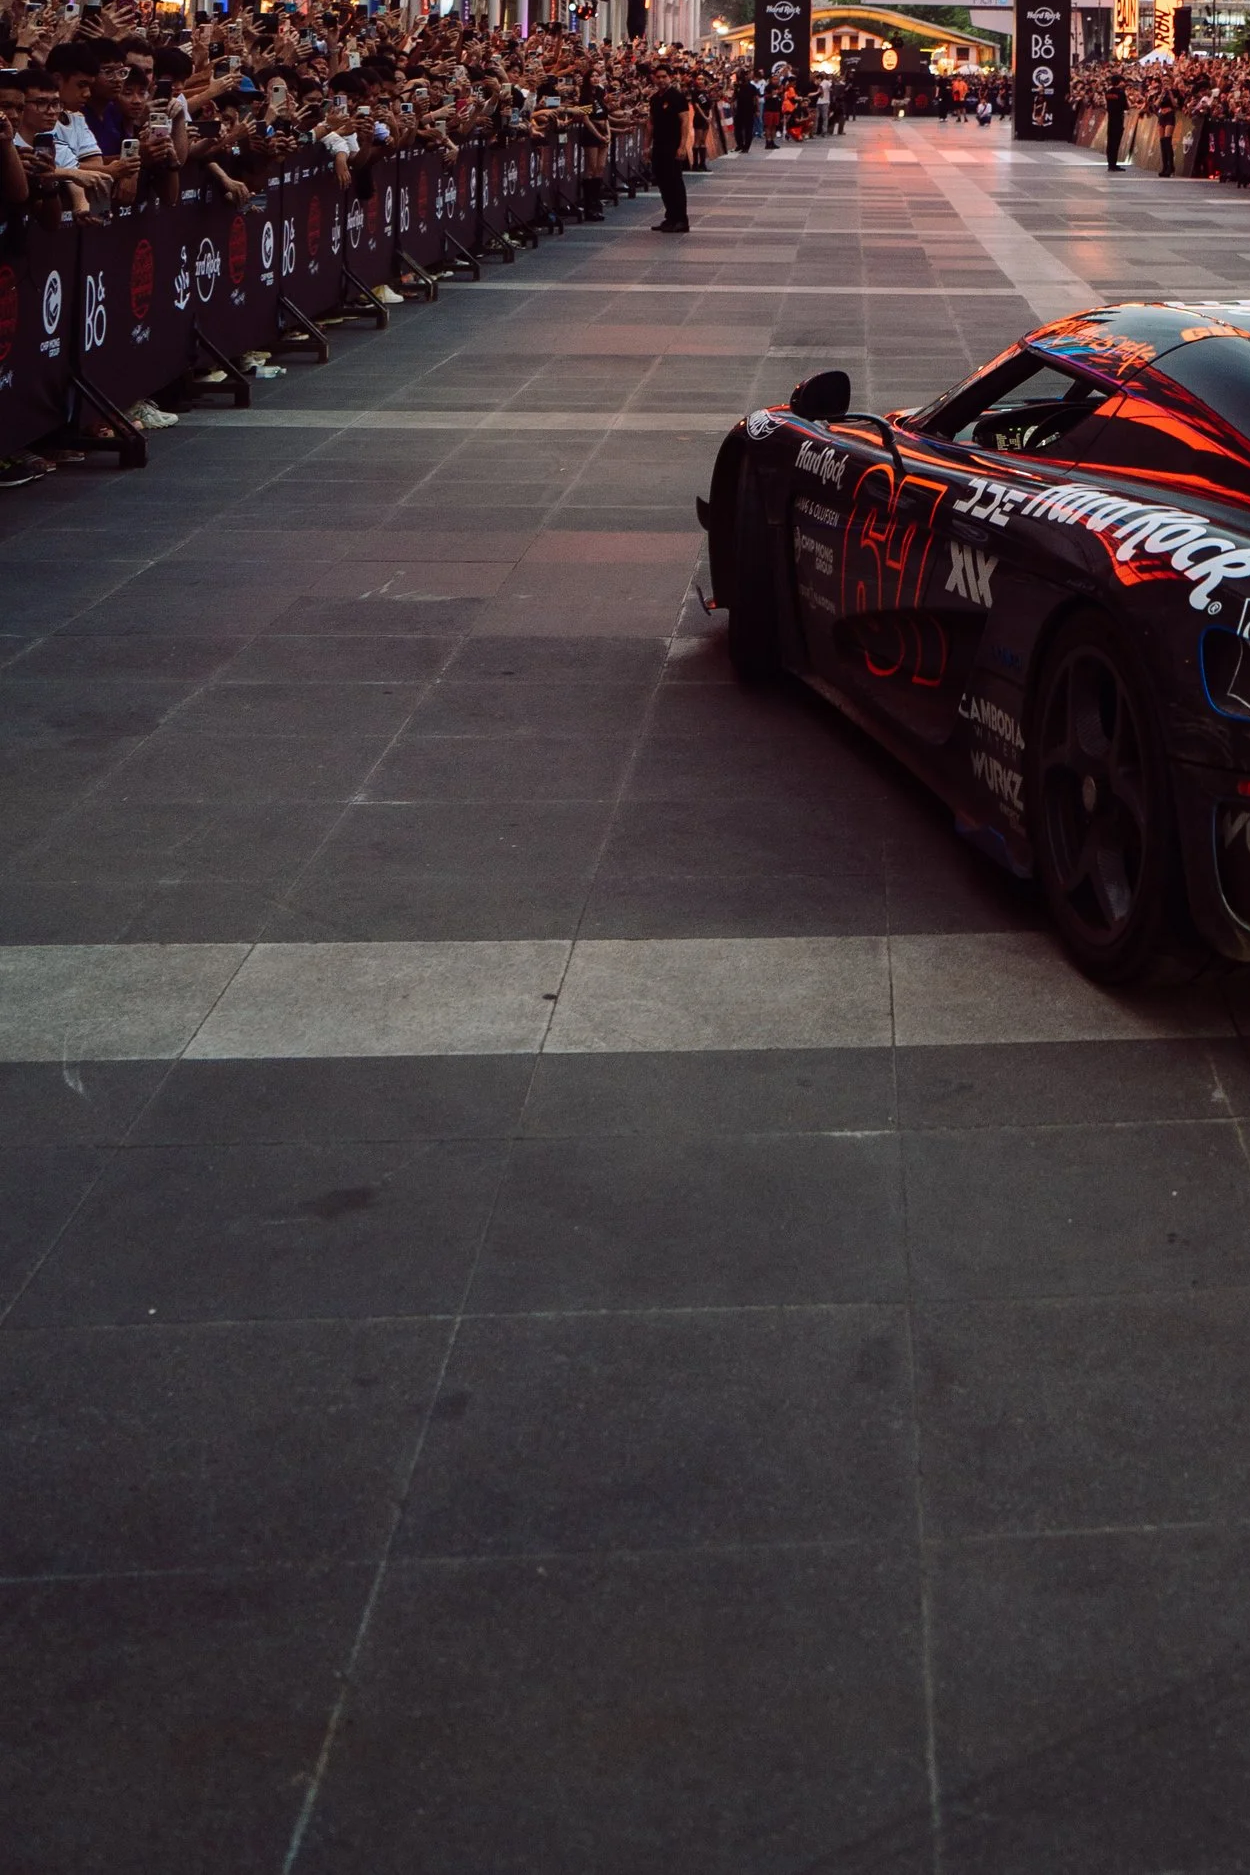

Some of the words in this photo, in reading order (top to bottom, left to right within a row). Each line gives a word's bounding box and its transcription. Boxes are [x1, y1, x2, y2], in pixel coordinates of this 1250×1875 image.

[795, 440, 824, 477] Hard
[820, 446, 849, 491] Rock
[1020, 482, 1143, 532] Hard
[958, 692, 1026, 751] CAMBODIA
